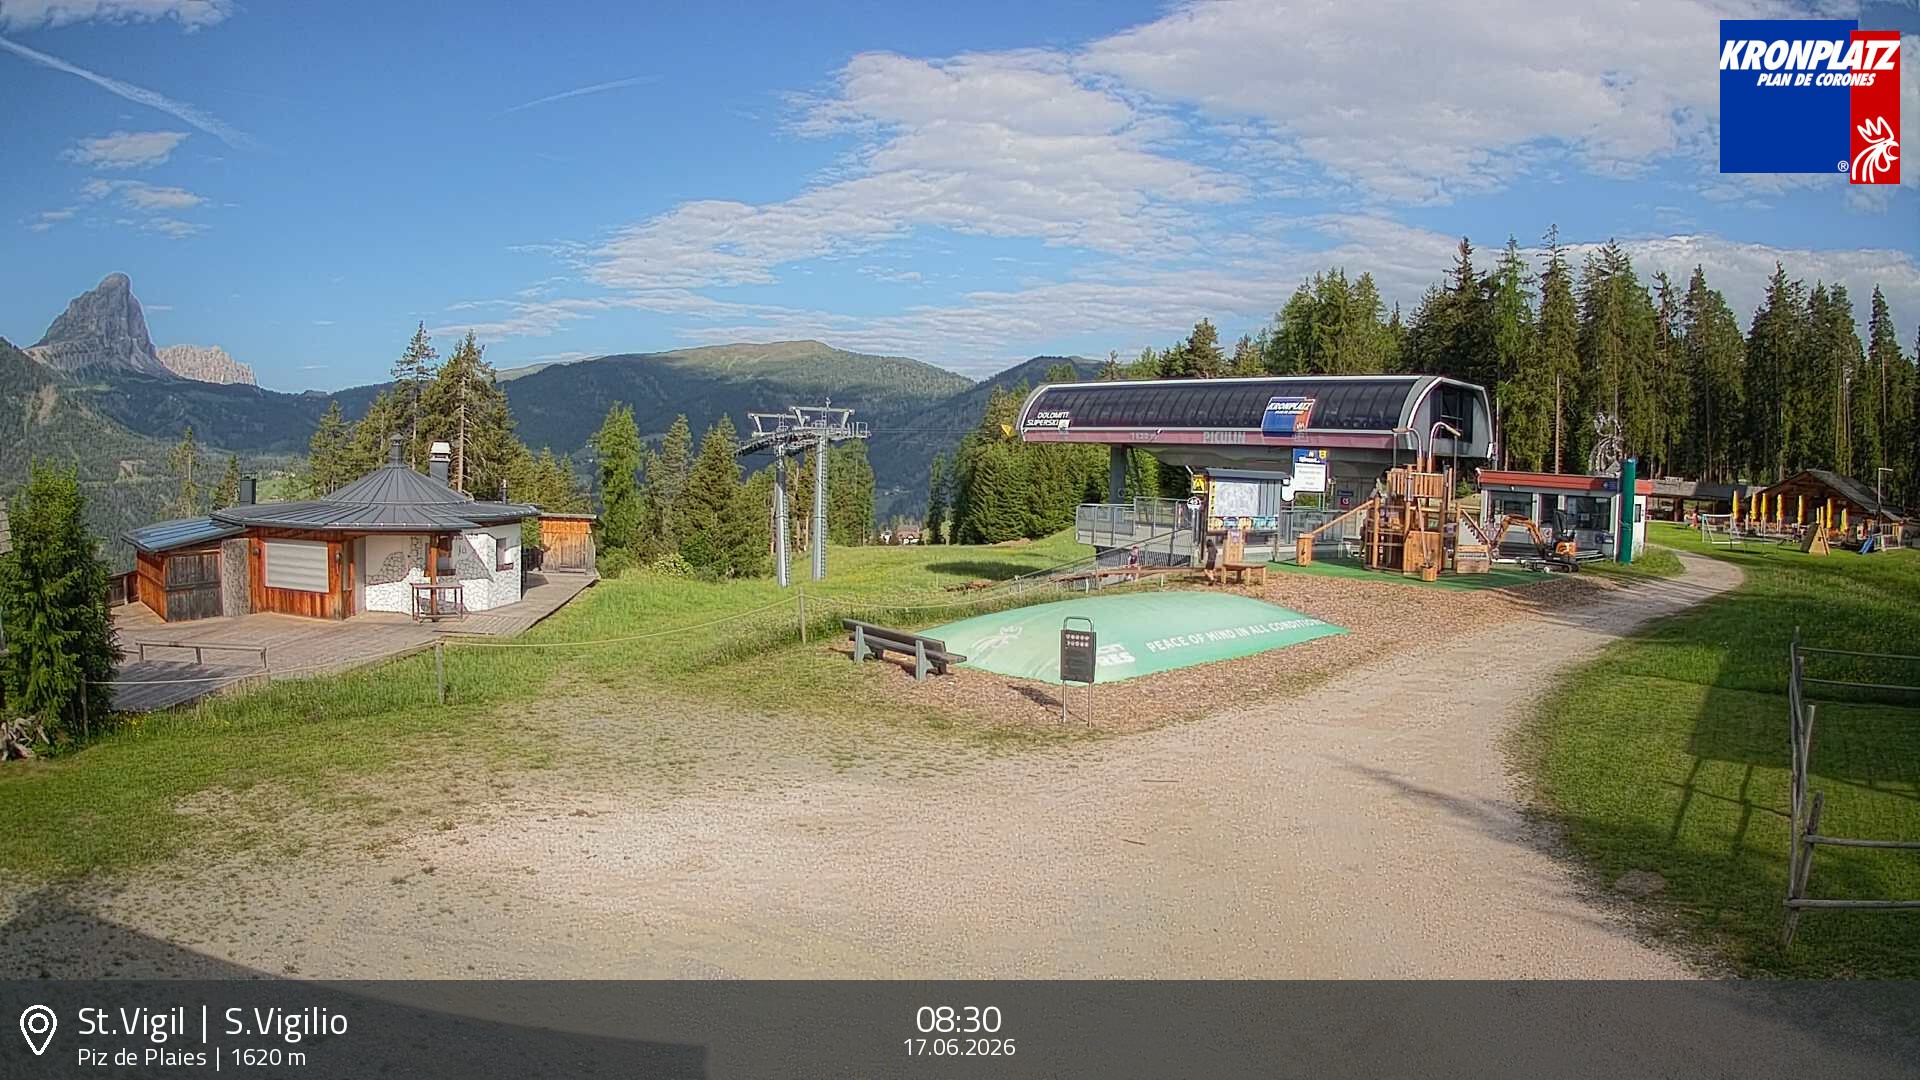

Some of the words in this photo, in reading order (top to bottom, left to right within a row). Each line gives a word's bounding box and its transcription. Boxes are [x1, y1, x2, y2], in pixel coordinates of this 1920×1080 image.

[1037, 411, 1069, 419] DOLOMITI
[1145, 636, 1189, 653] PEACE
[1188, 632, 1204, 645] OF
[1205, 629, 1236, 641] MIND
[1234, 626, 1250, 638] IN
[1248, 624, 1270, 634] ALL
